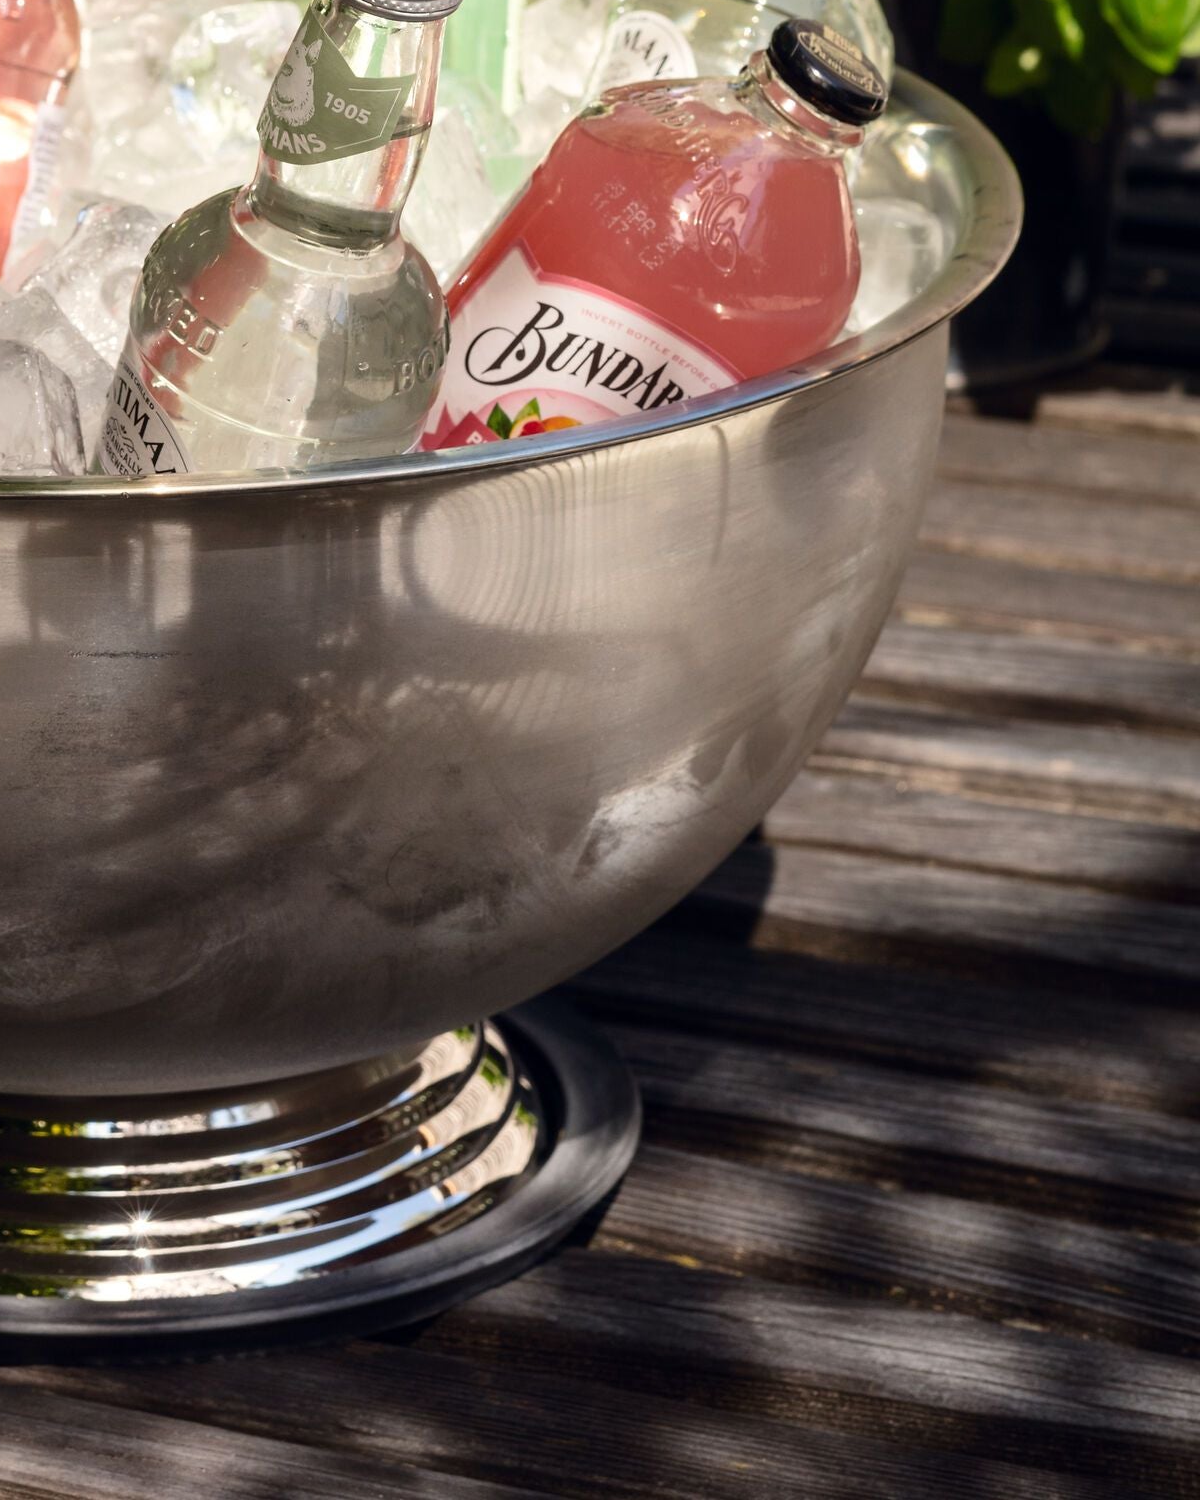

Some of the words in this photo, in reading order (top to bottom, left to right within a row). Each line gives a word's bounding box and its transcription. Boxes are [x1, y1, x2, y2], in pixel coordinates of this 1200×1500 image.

[324, 91, 372, 125] 1905
[581, 307, 624, 332] INVERT
[626, 329, 669, 357] BOTTLE
[671, 354, 711, 384] BEFORE
